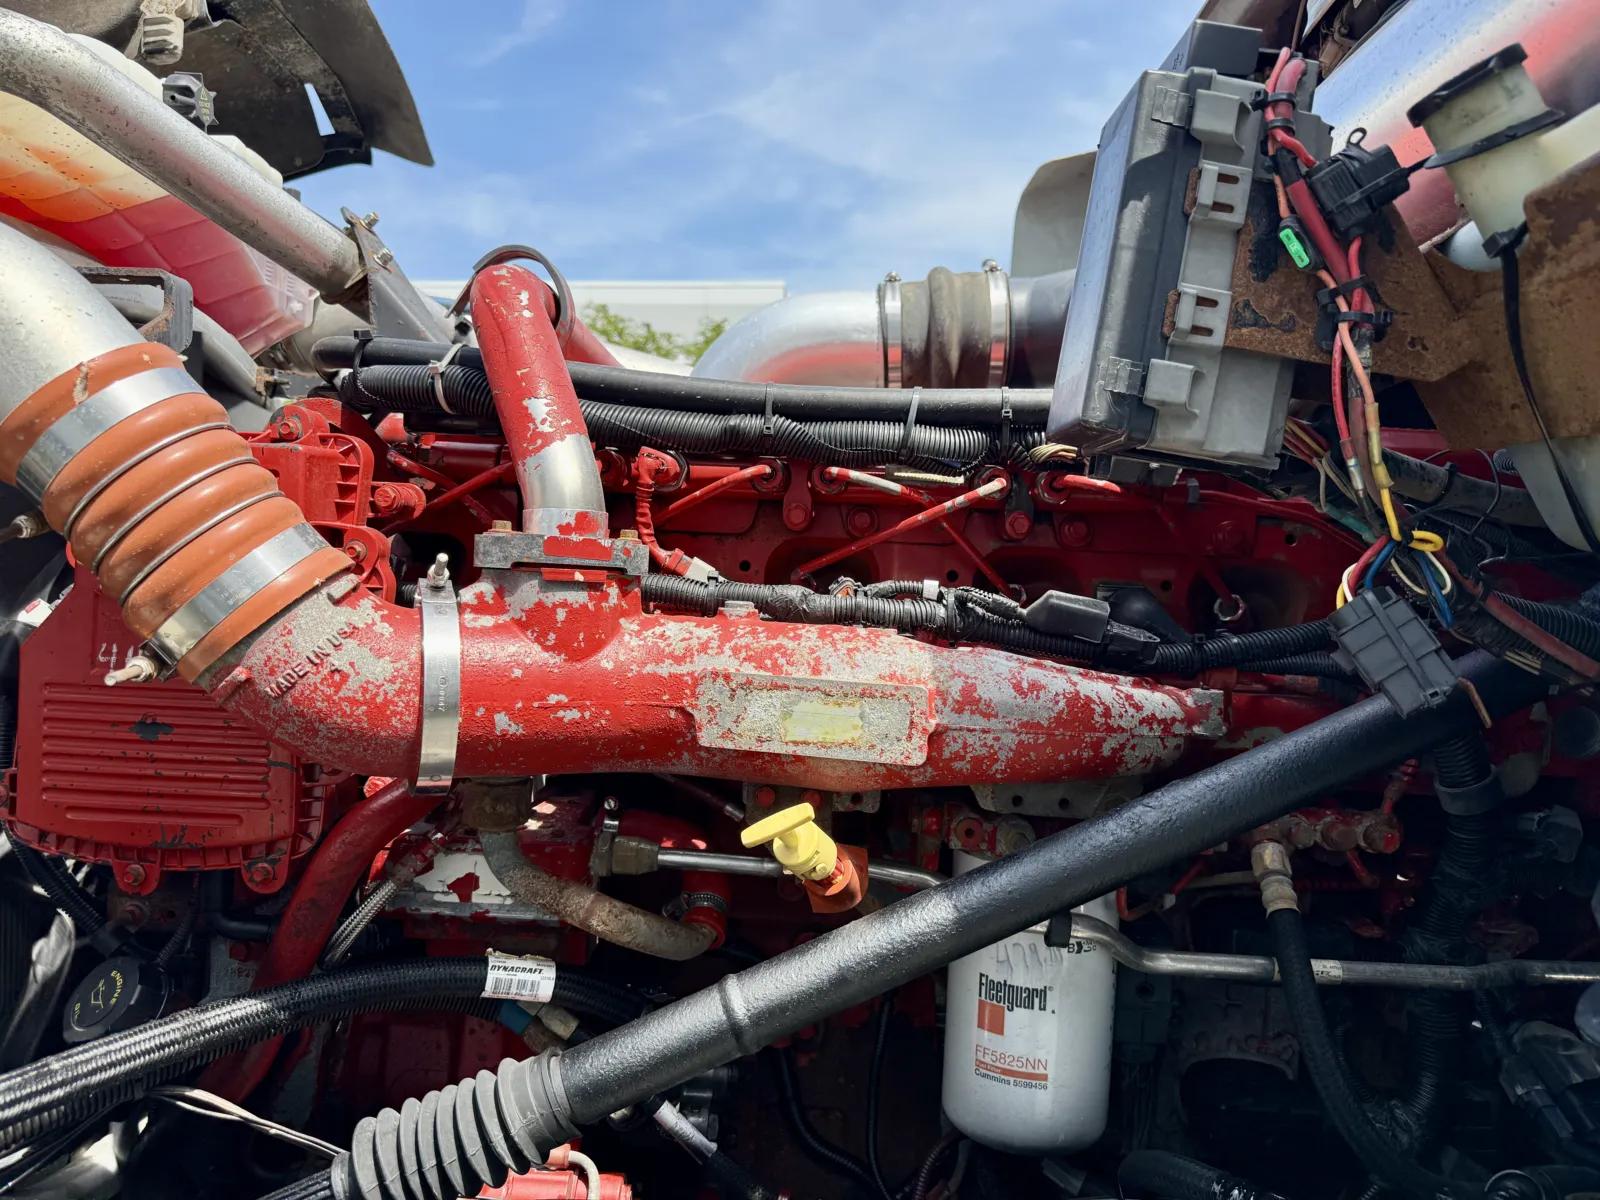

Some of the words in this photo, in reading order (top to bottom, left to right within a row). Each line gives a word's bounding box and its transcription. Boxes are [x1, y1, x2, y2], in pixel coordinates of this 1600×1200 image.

[264, 663, 309, 699] MADE
[306, 646, 330, 666] IN
[489, 964, 544, 975] DYNACRAFT
[111, 970, 123, 1005] ENGINE
[978, 972, 1047, 1012] Fleetguard
[975, 1044, 1048, 1071] FF5825NN
[974, 1068, 1011, 1086] Cummins
[1012, 1081, 1048, 1091] 5599456
